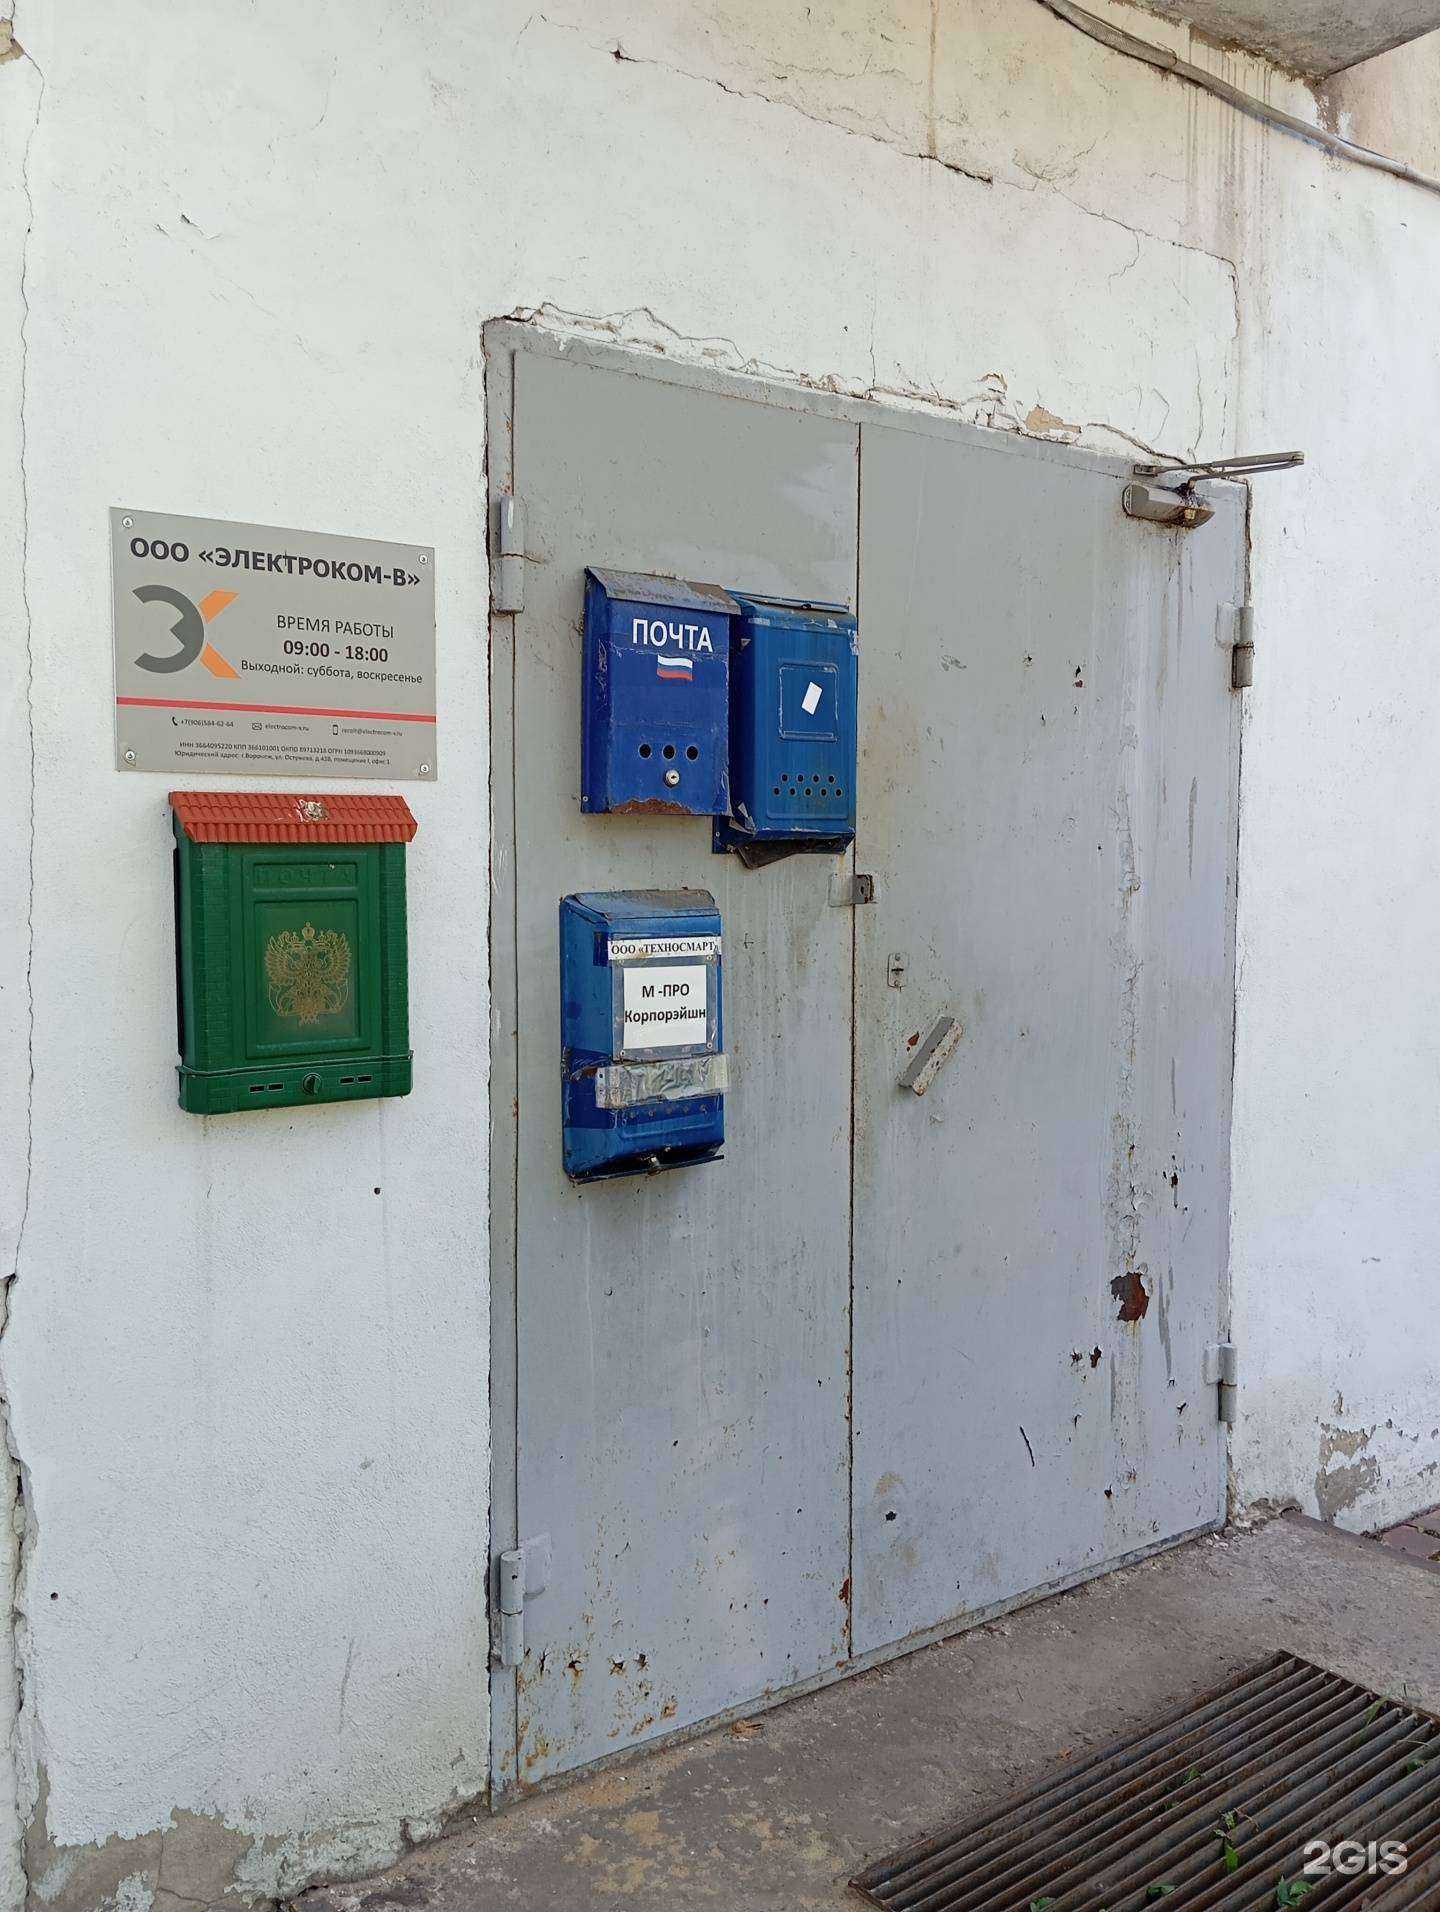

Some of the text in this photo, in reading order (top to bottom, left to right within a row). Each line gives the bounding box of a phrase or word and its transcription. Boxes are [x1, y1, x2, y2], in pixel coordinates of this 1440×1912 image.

[129, 537, 420, 587] ООО «ЭЛЕКТРОКОМ-В»
[277, 615, 394, 639] ВРЕМЯ РАБОТЫ
[632, 618, 714, 653] ПОЧТА
[283, 640, 330, 658] 09:00
[345, 645, 388, 662] 18:00
[241, 659, 423, 684] Выходной: суббота, воскресенье
[611, 940, 718, 955] ООО «ТЕХНОСМАРТ»
[642, 984, 655, 998] М
[624, 1006, 707, 1026] Корпорэйшн
